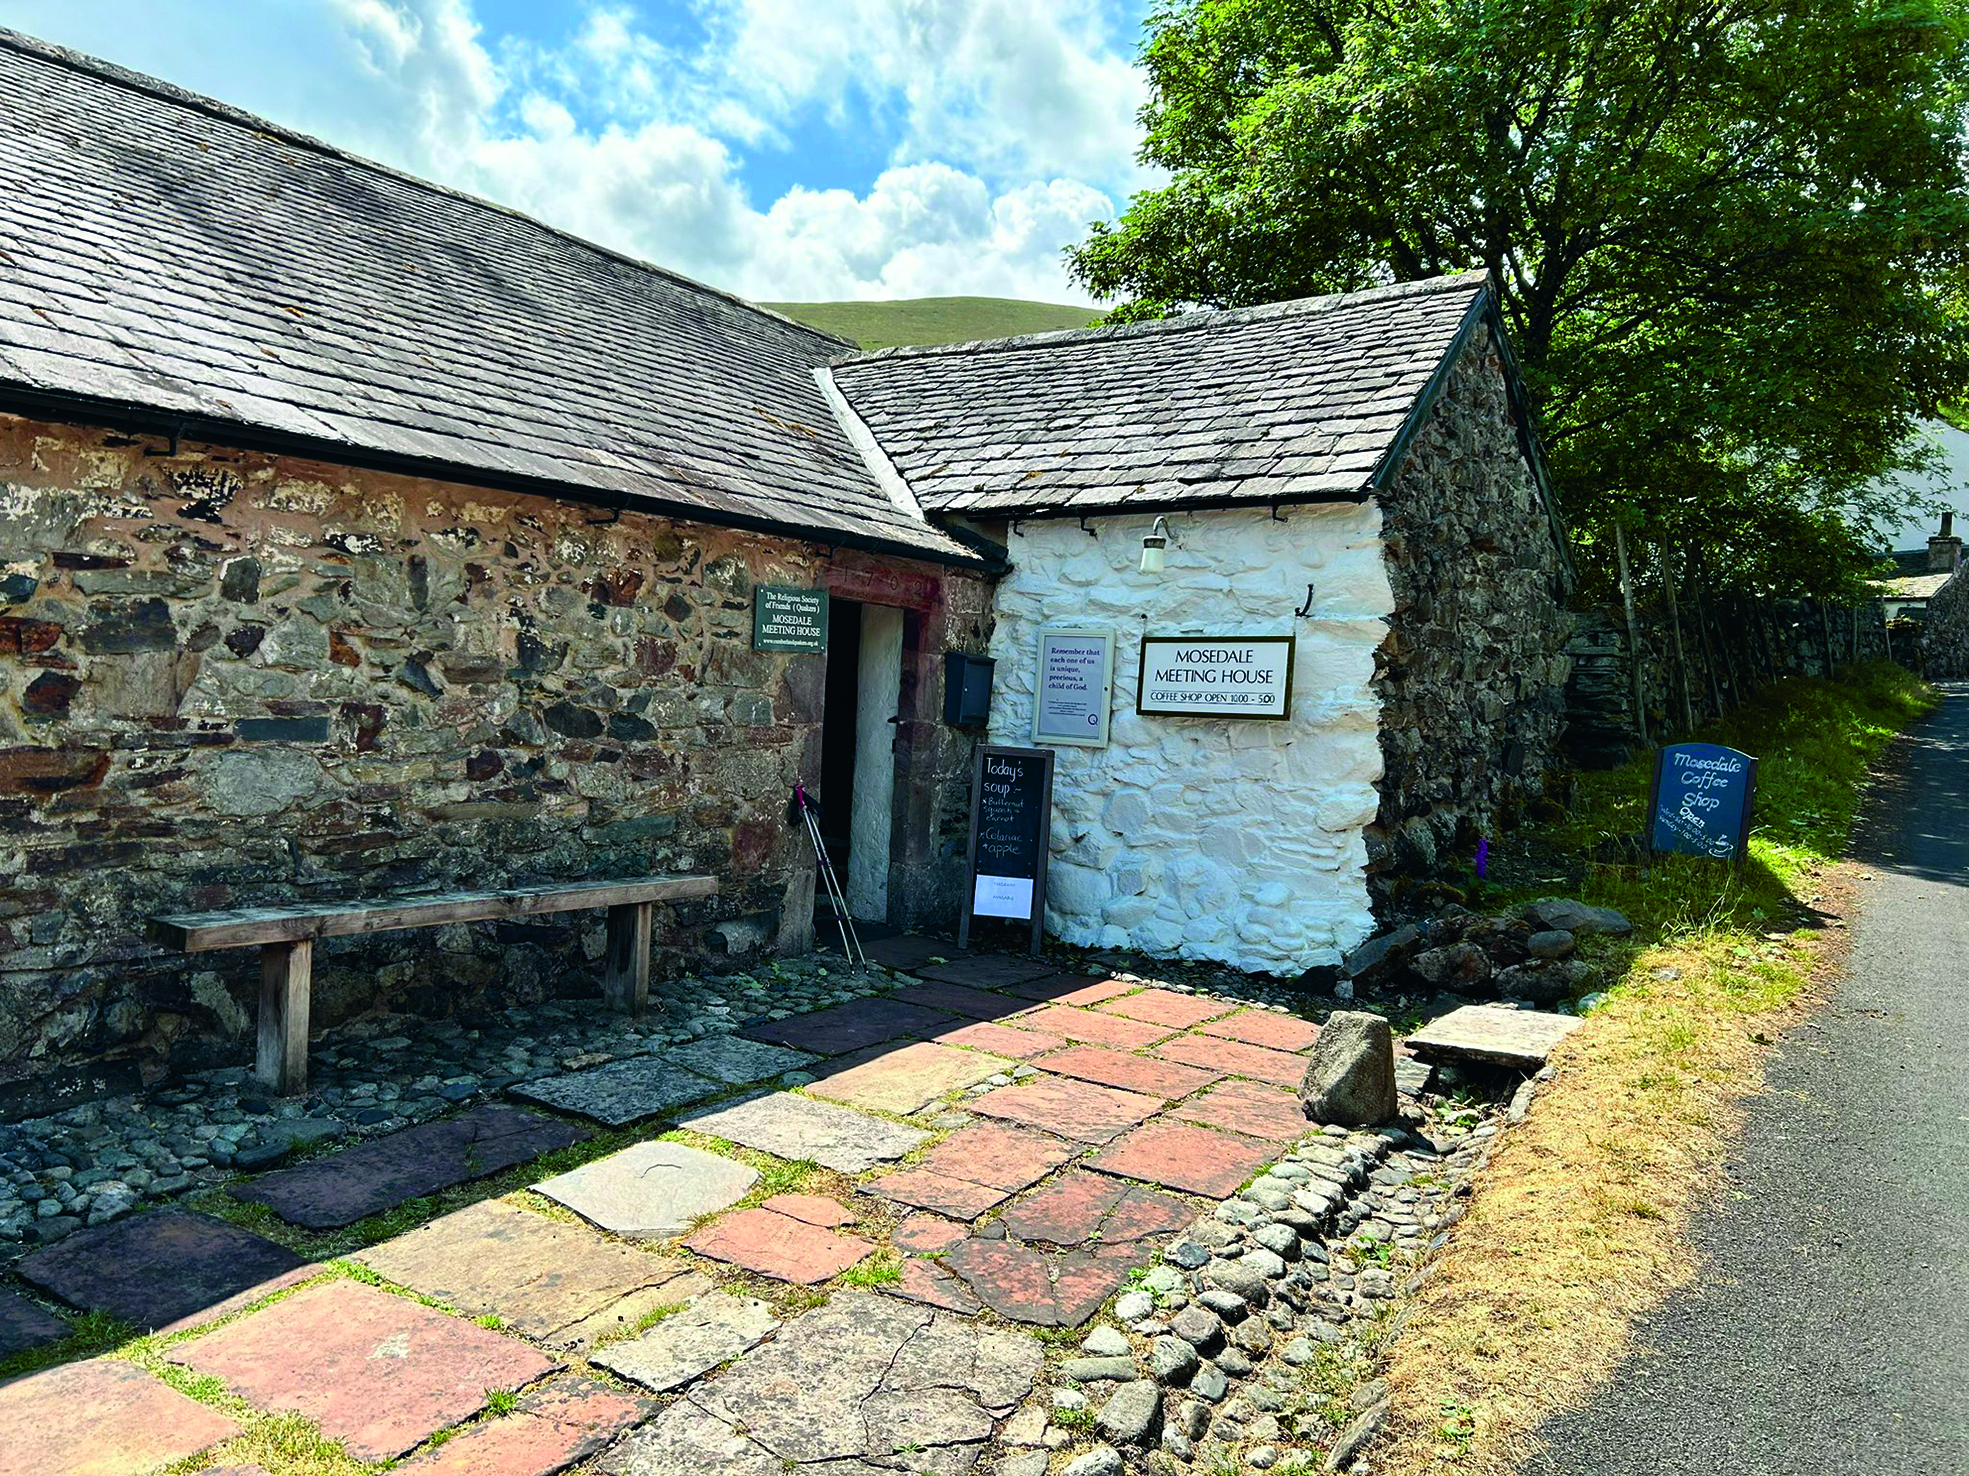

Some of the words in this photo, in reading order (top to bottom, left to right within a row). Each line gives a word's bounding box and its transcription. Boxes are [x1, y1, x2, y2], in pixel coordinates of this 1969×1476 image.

[766, 592, 776, 600] The
[777, 593, 800, 603] Religious
[801, 595, 820, 605] Society
[772, 602, 791, 610] Friends
[772, 614, 812, 626] MOSEDALE
[762, 624, 796, 635] MEETING
[797, 627, 821, 636] HOUSE
[1051, 647, 1085, 655] Remember
[1086, 648, 1100, 656] that
[1175, 649, 1254, 663] MOSEDALE
[1057, 666, 1080, 674] unique,
[1155, 669, 1216, 683] MEETING
[1221, 669, 1273, 684] HOUSE
[1150, 692, 1178, 701] COFFEE
[1180, 693, 1202, 702] SHOP
[1205, 693, 1227, 702] OPEN
[986, 757, 1024, 782] Today's
[1674, 753, 1741, 773] Mosedale
[1681, 771, 1729, 789] Coffee
[988, 796, 1024, 808] Butternut
[1682, 791, 1720, 811] Shop
[988, 844, 1022, 858] apple
